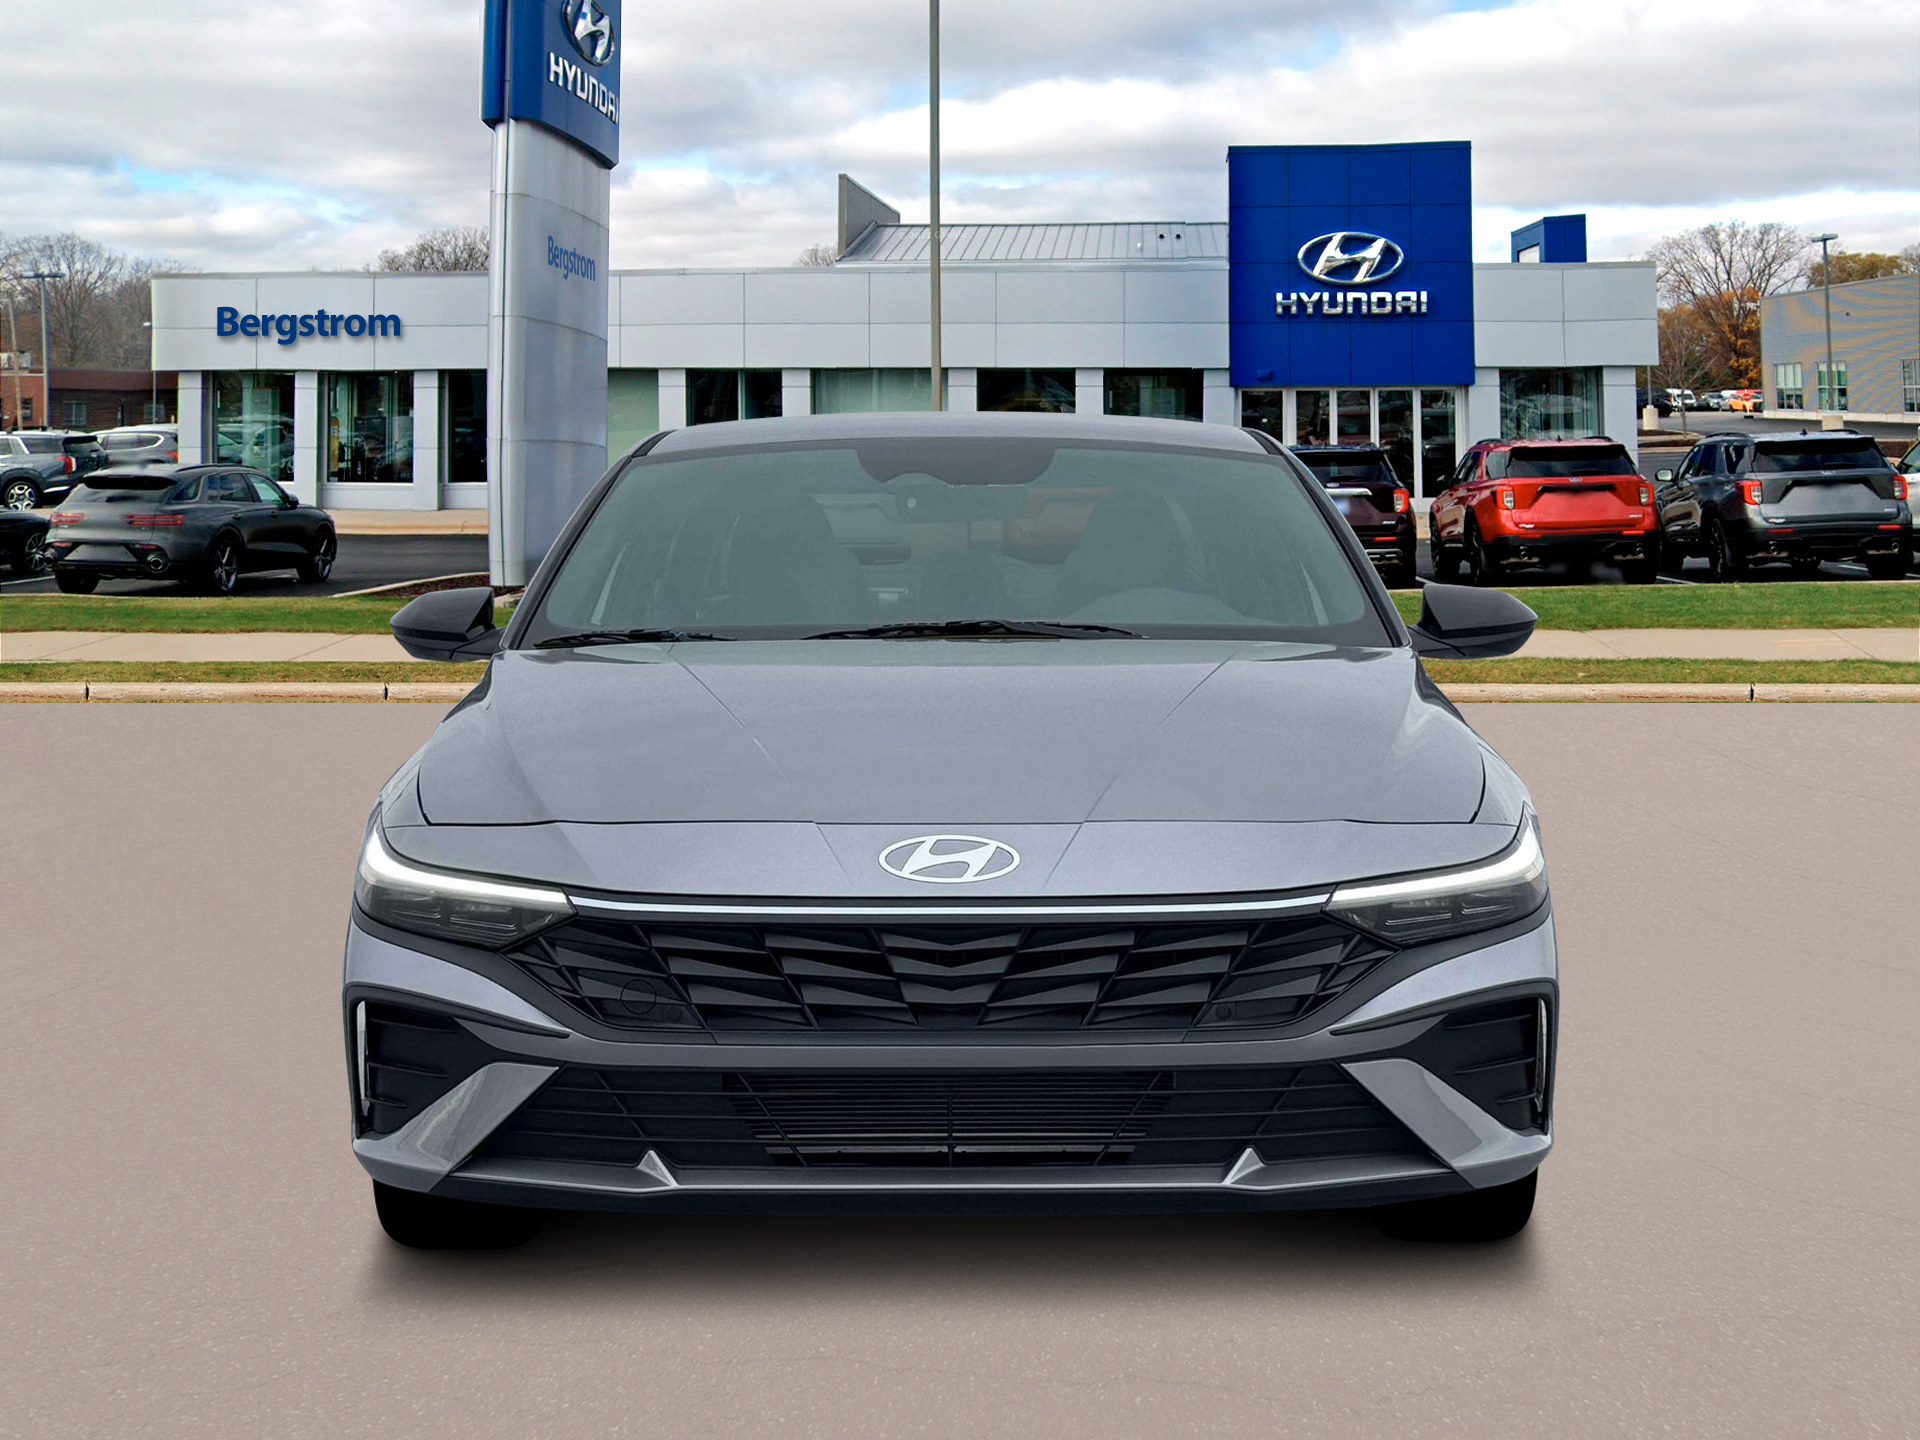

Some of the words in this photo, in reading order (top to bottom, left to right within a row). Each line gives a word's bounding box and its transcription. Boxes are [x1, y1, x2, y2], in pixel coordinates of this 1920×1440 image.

[549, 52, 619, 124] HYUNDAI
[547, 235, 596, 282] Bergstrom
[1275, 290, 1428, 315] HYUNDAI
[216, 306, 401, 346] Bergstrom
